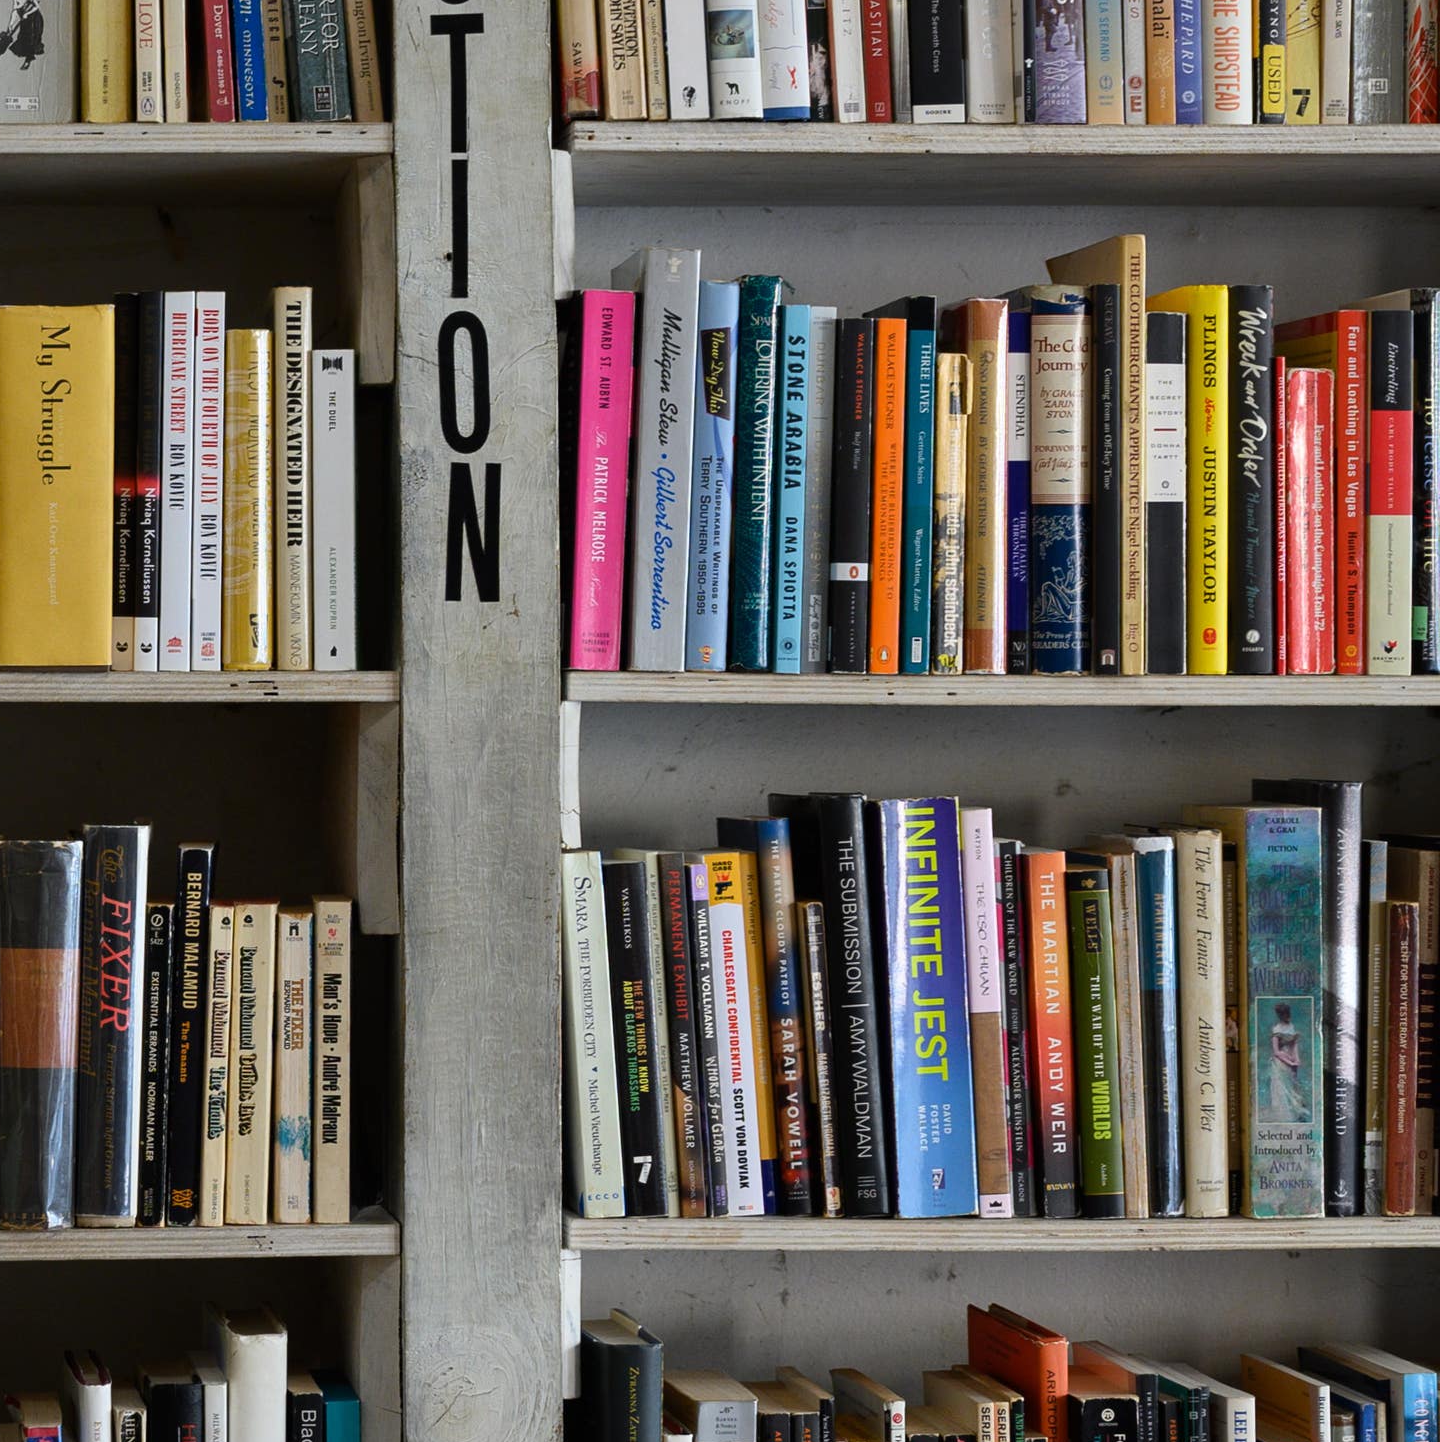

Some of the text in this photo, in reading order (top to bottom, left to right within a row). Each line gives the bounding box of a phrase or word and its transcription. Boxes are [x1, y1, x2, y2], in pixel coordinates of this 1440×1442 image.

[1214, 27, 1239, 111] SHIPSTEAD
[1268, 54, 1282, 104] USED
[36, 325, 71, 486] My Struggle
[286, 301, 305, 547] THE DESIGNATED HEIR
[656, 308, 681, 445] Mulligan Stew
[1203, 314, 1217, 604] FLINGS JUSTIN TAYLOR
[903, 806, 948, 1081] INFINITE JEST
[1040, 872, 1067, 1154] THE MARTIAN ANDY WEIR
[918, 1105, 929, 1151] WALLACE
[930, 1105, 940, 1144] FOSTER
[942, 1104, 952, 1134] DAVID
